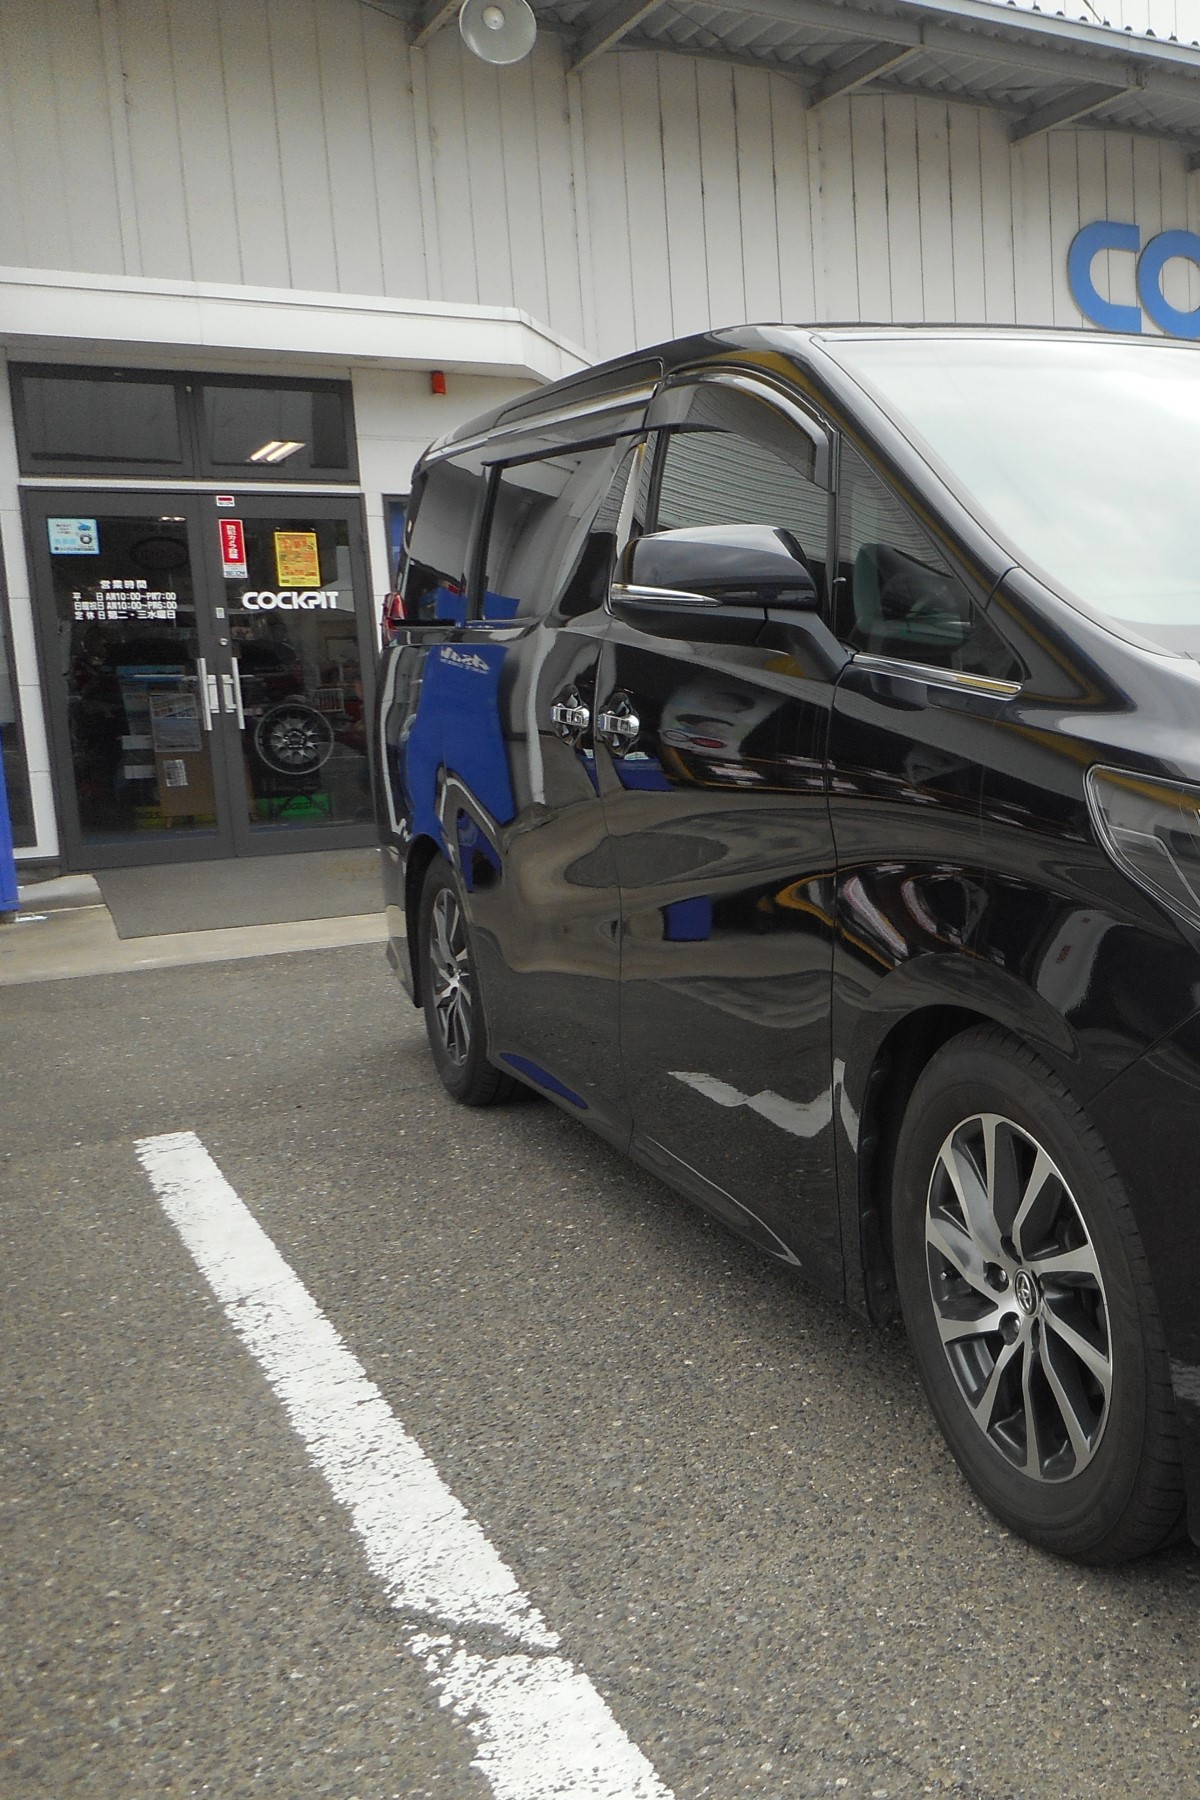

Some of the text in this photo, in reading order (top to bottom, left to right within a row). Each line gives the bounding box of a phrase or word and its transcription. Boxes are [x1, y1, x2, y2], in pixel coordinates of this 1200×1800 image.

[100, 580, 148, 590] 営業時間
[242, 591, 339, 610] COCKPIT
